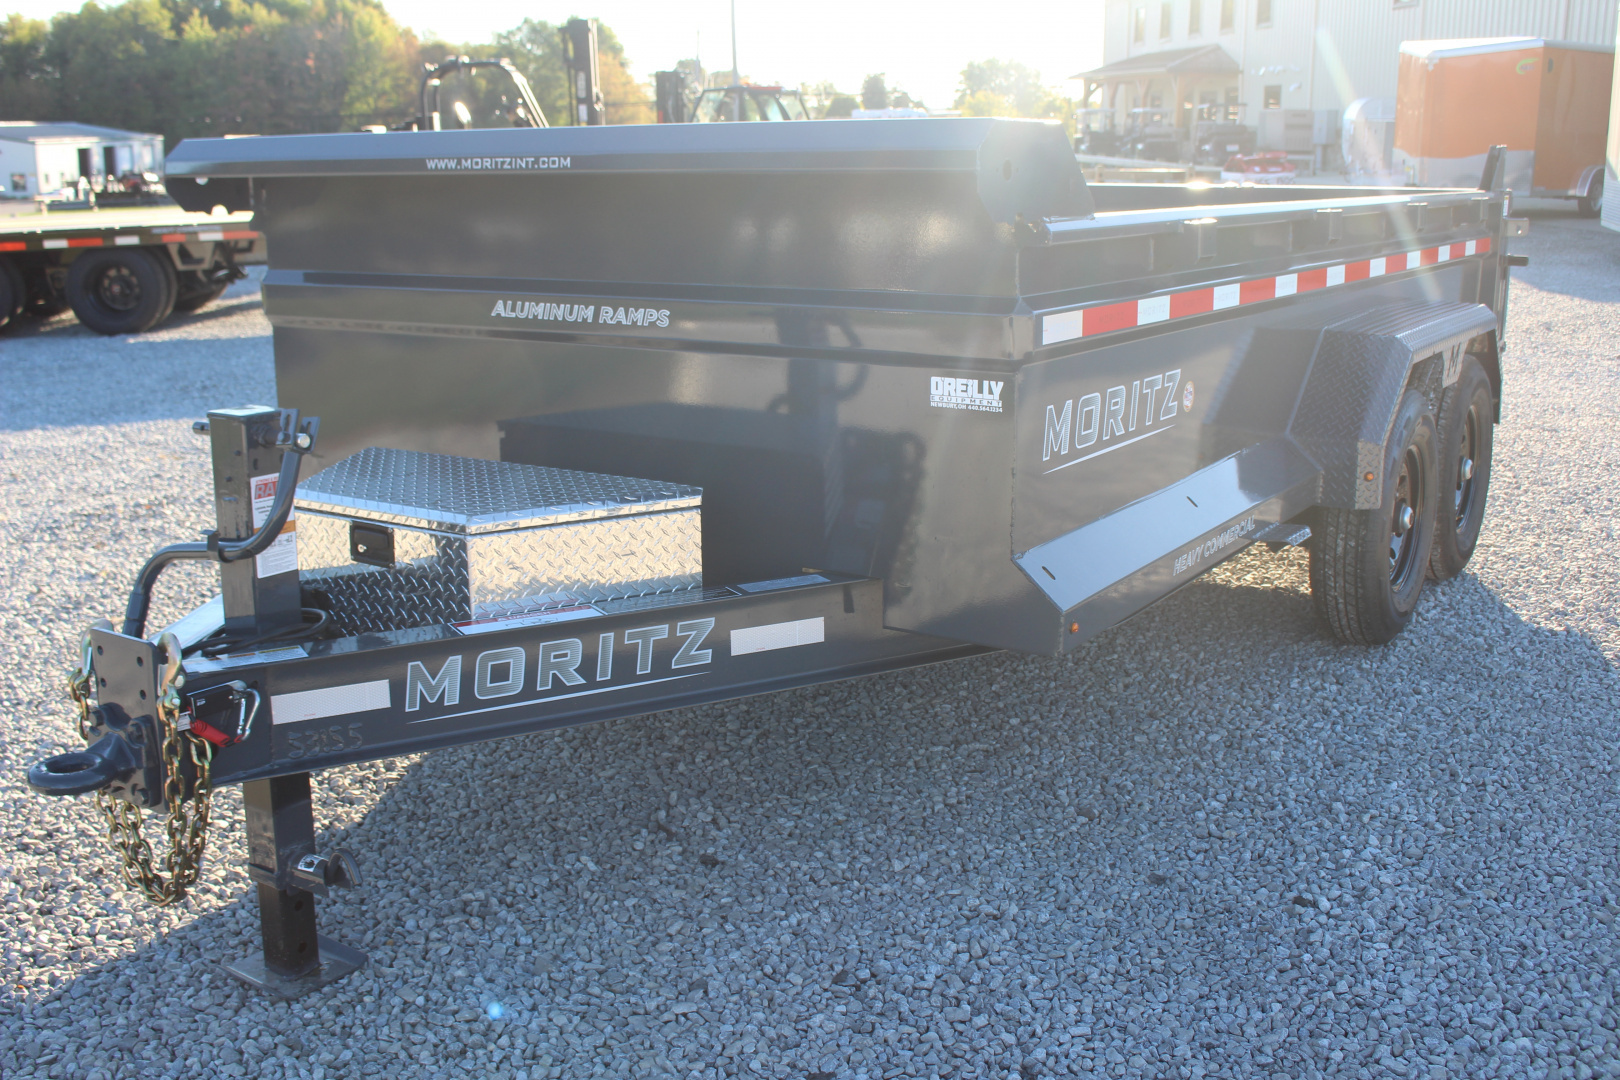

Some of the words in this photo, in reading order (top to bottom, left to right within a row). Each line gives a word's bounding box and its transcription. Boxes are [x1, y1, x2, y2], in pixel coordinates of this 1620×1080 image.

[426, 157, 571, 170] WWW.MORITZINT.COM
[491, 300, 594, 323] ALUMINUM
[599, 306, 670, 327] RAMPS
[931, 395, 1002, 407] EQUIPMENT
[1043, 369, 1181, 462] MORITZ
[1172, 544, 1204, 577] HEAVY
[1203, 514, 1256, 558] COMMERCIAL
[405, 617, 715, 712] MORITZ
